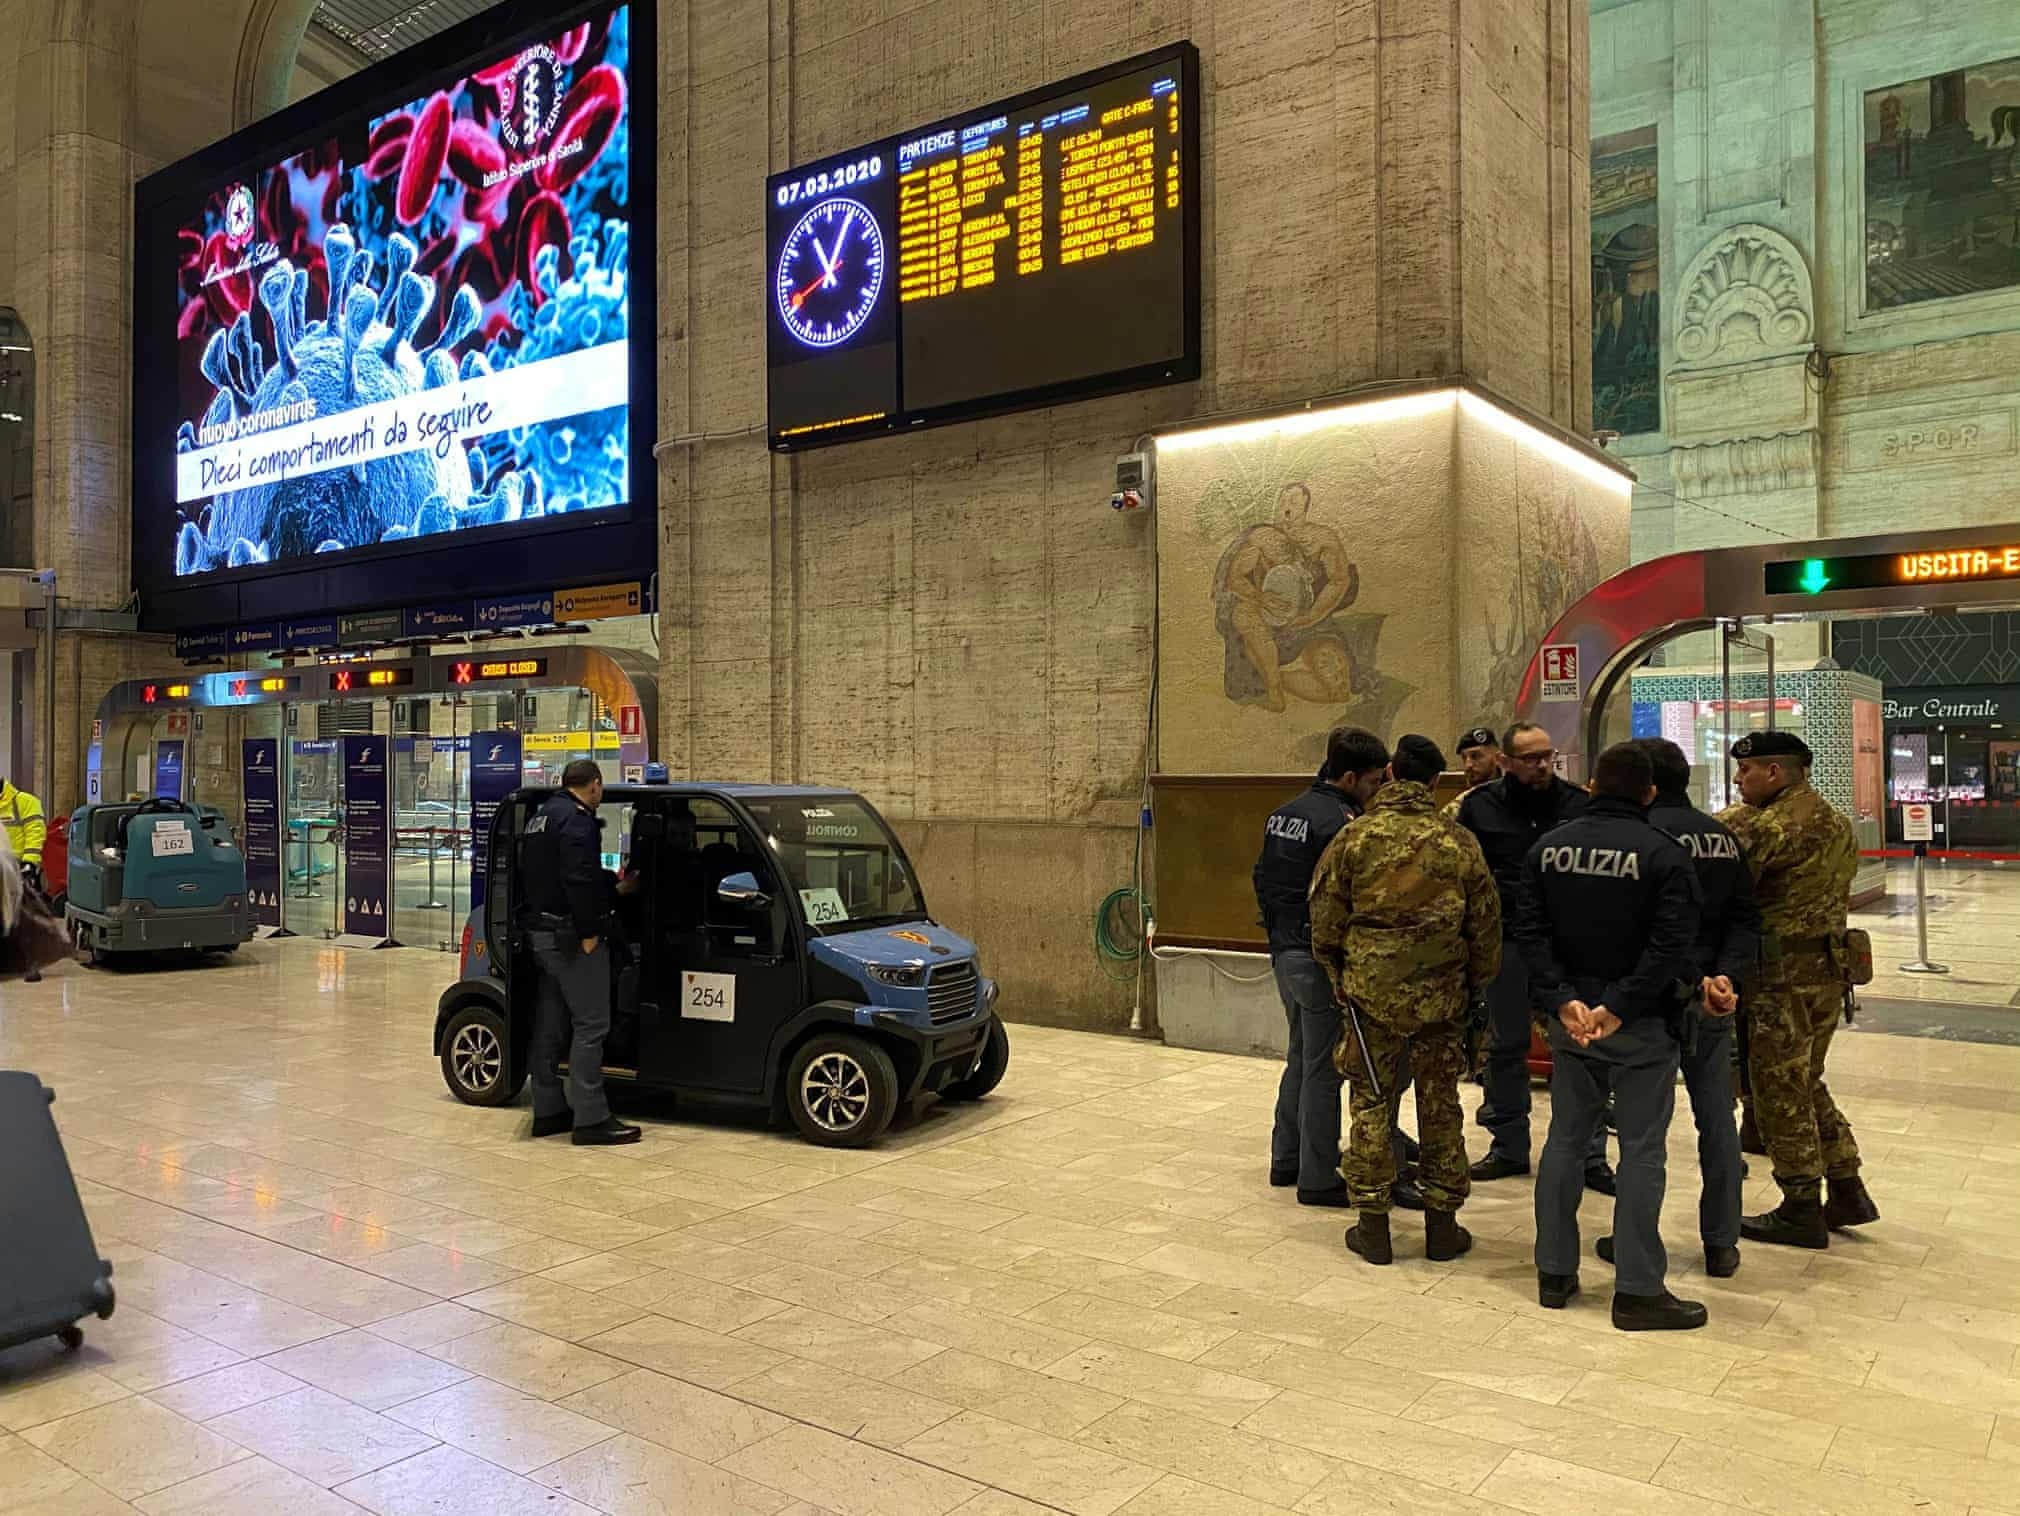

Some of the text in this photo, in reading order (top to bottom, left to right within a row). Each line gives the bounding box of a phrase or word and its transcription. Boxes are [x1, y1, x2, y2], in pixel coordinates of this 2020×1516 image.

[899, 130, 955, 160] PARTENZE
[777, 156, 881, 206] 07.03.2020
[198, 398, 316, 446] nuovo coronavirus
[201, 392, 492, 491] Dieci comportamenti da seguire
[1880, 698, 2000, 719] Bar Centrale
[1265, 815, 1309, 843] POLIZIA
[163, 839, 185, 850] 162
[1678, 832, 1740, 861] OLIZIA
[1541, 846, 1640, 880] POLIZIA
[812, 901, 840, 921] 254
[692, 987, 724, 1009] 254
